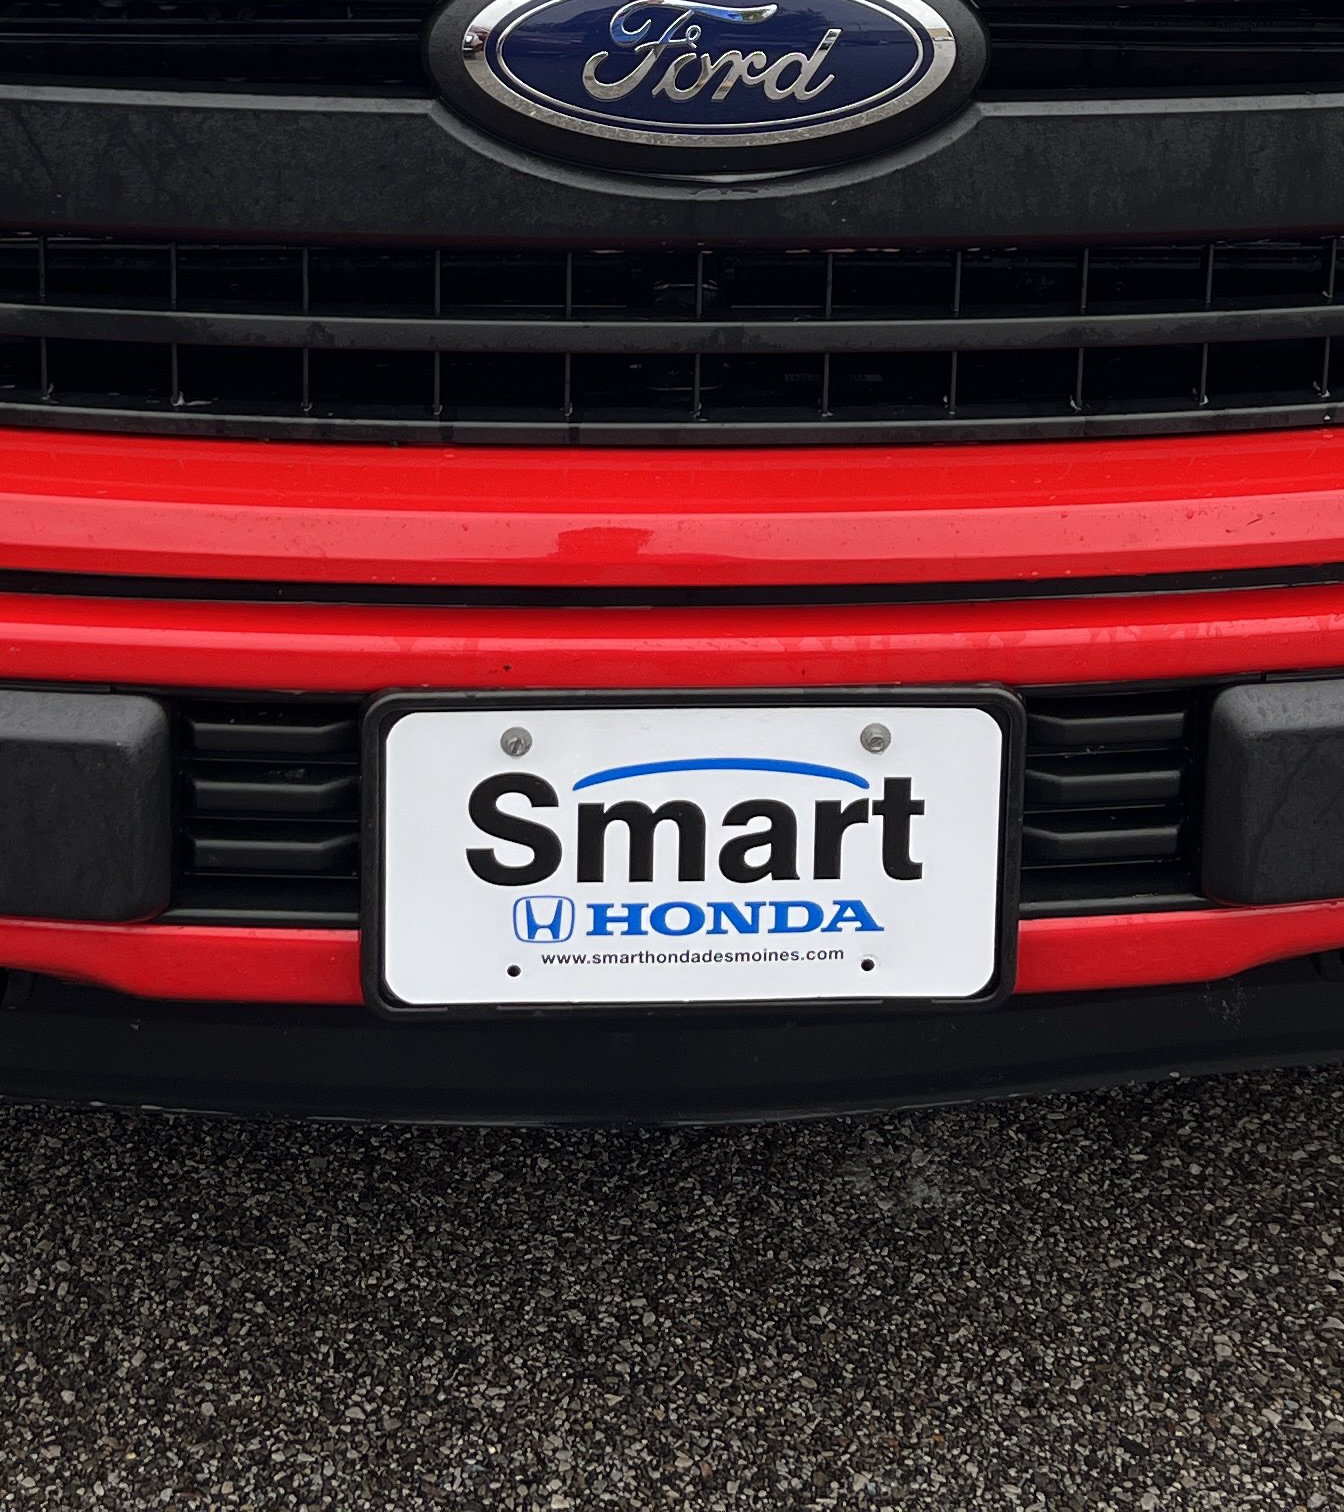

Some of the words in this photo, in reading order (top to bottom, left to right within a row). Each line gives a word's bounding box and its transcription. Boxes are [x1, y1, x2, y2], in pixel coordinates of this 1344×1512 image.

[464, 771, 925, 886] Smart
[585, 898, 885, 937] HONDA
[541, 947, 844, 966] www.smarthondadesmoines.com
